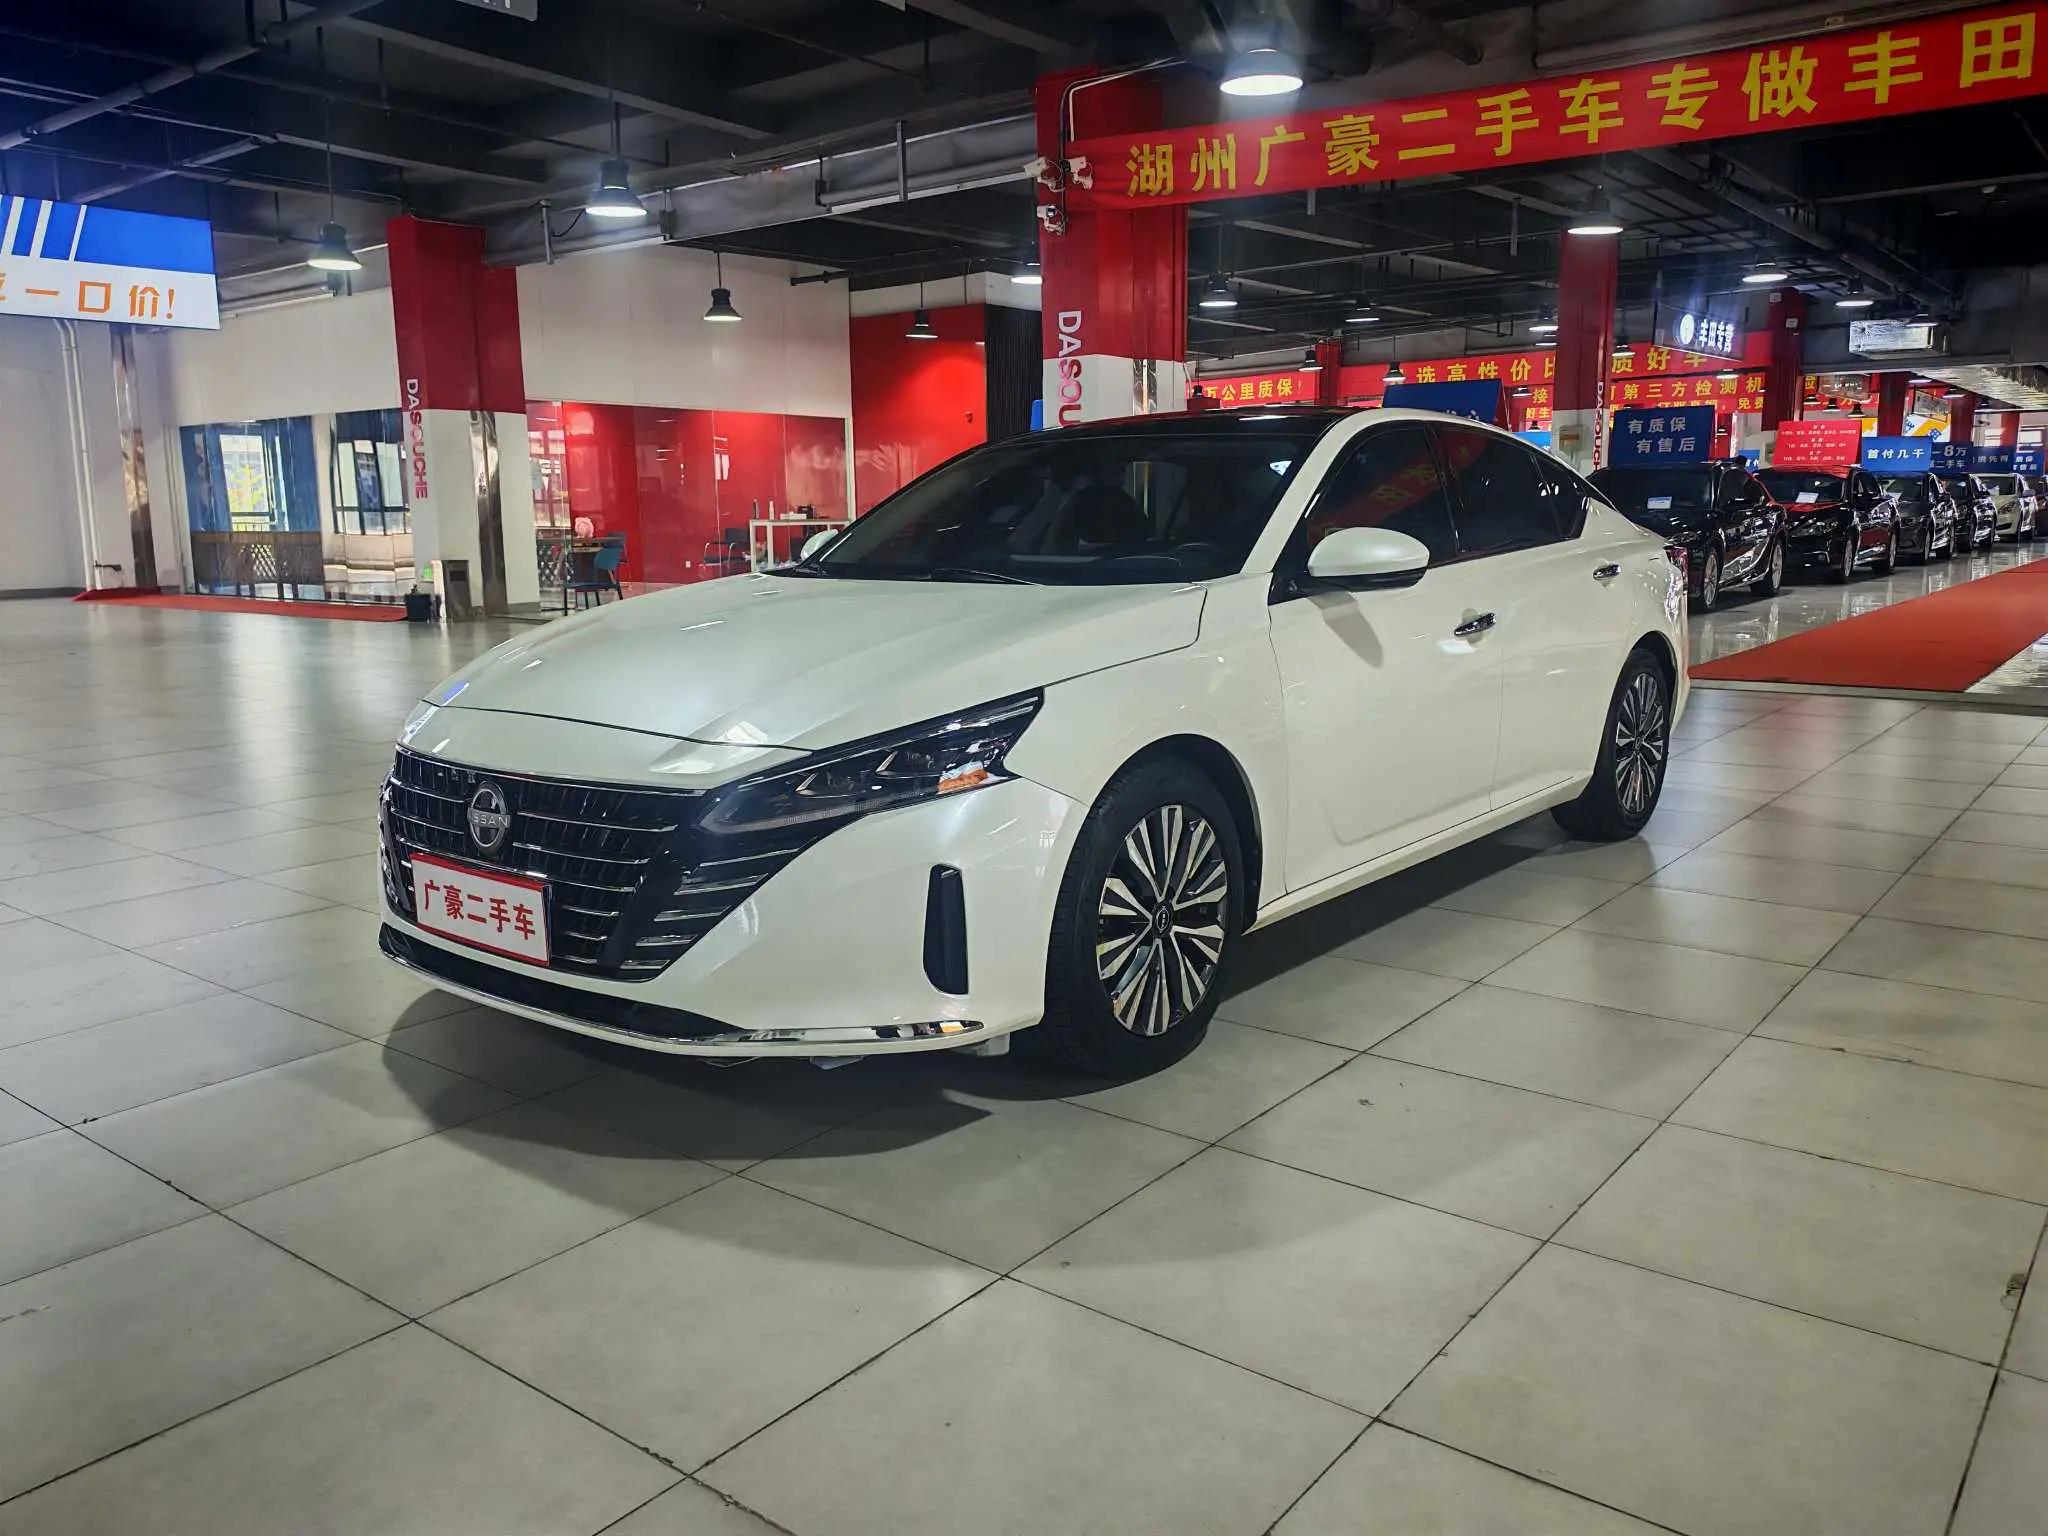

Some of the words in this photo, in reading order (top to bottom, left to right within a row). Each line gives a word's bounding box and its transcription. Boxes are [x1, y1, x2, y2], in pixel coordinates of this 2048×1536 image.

[1125, 12, 2037, 197] 湖州广豪二手车专做丰田
[0, 272, 176, 319] 一口价!
[1611, 377, 1761, 400] 第三方检测机
[1627, 416, 1687, 434] 有质保
[406, 379, 428, 499] DASOUCHE
[1636, 437, 1696, 454] 有售后
[1866, 448, 1925, 460] 首付几千
[468, 809, 509, 828] SSAN
[424, 879, 536, 940] 广豪二手车
